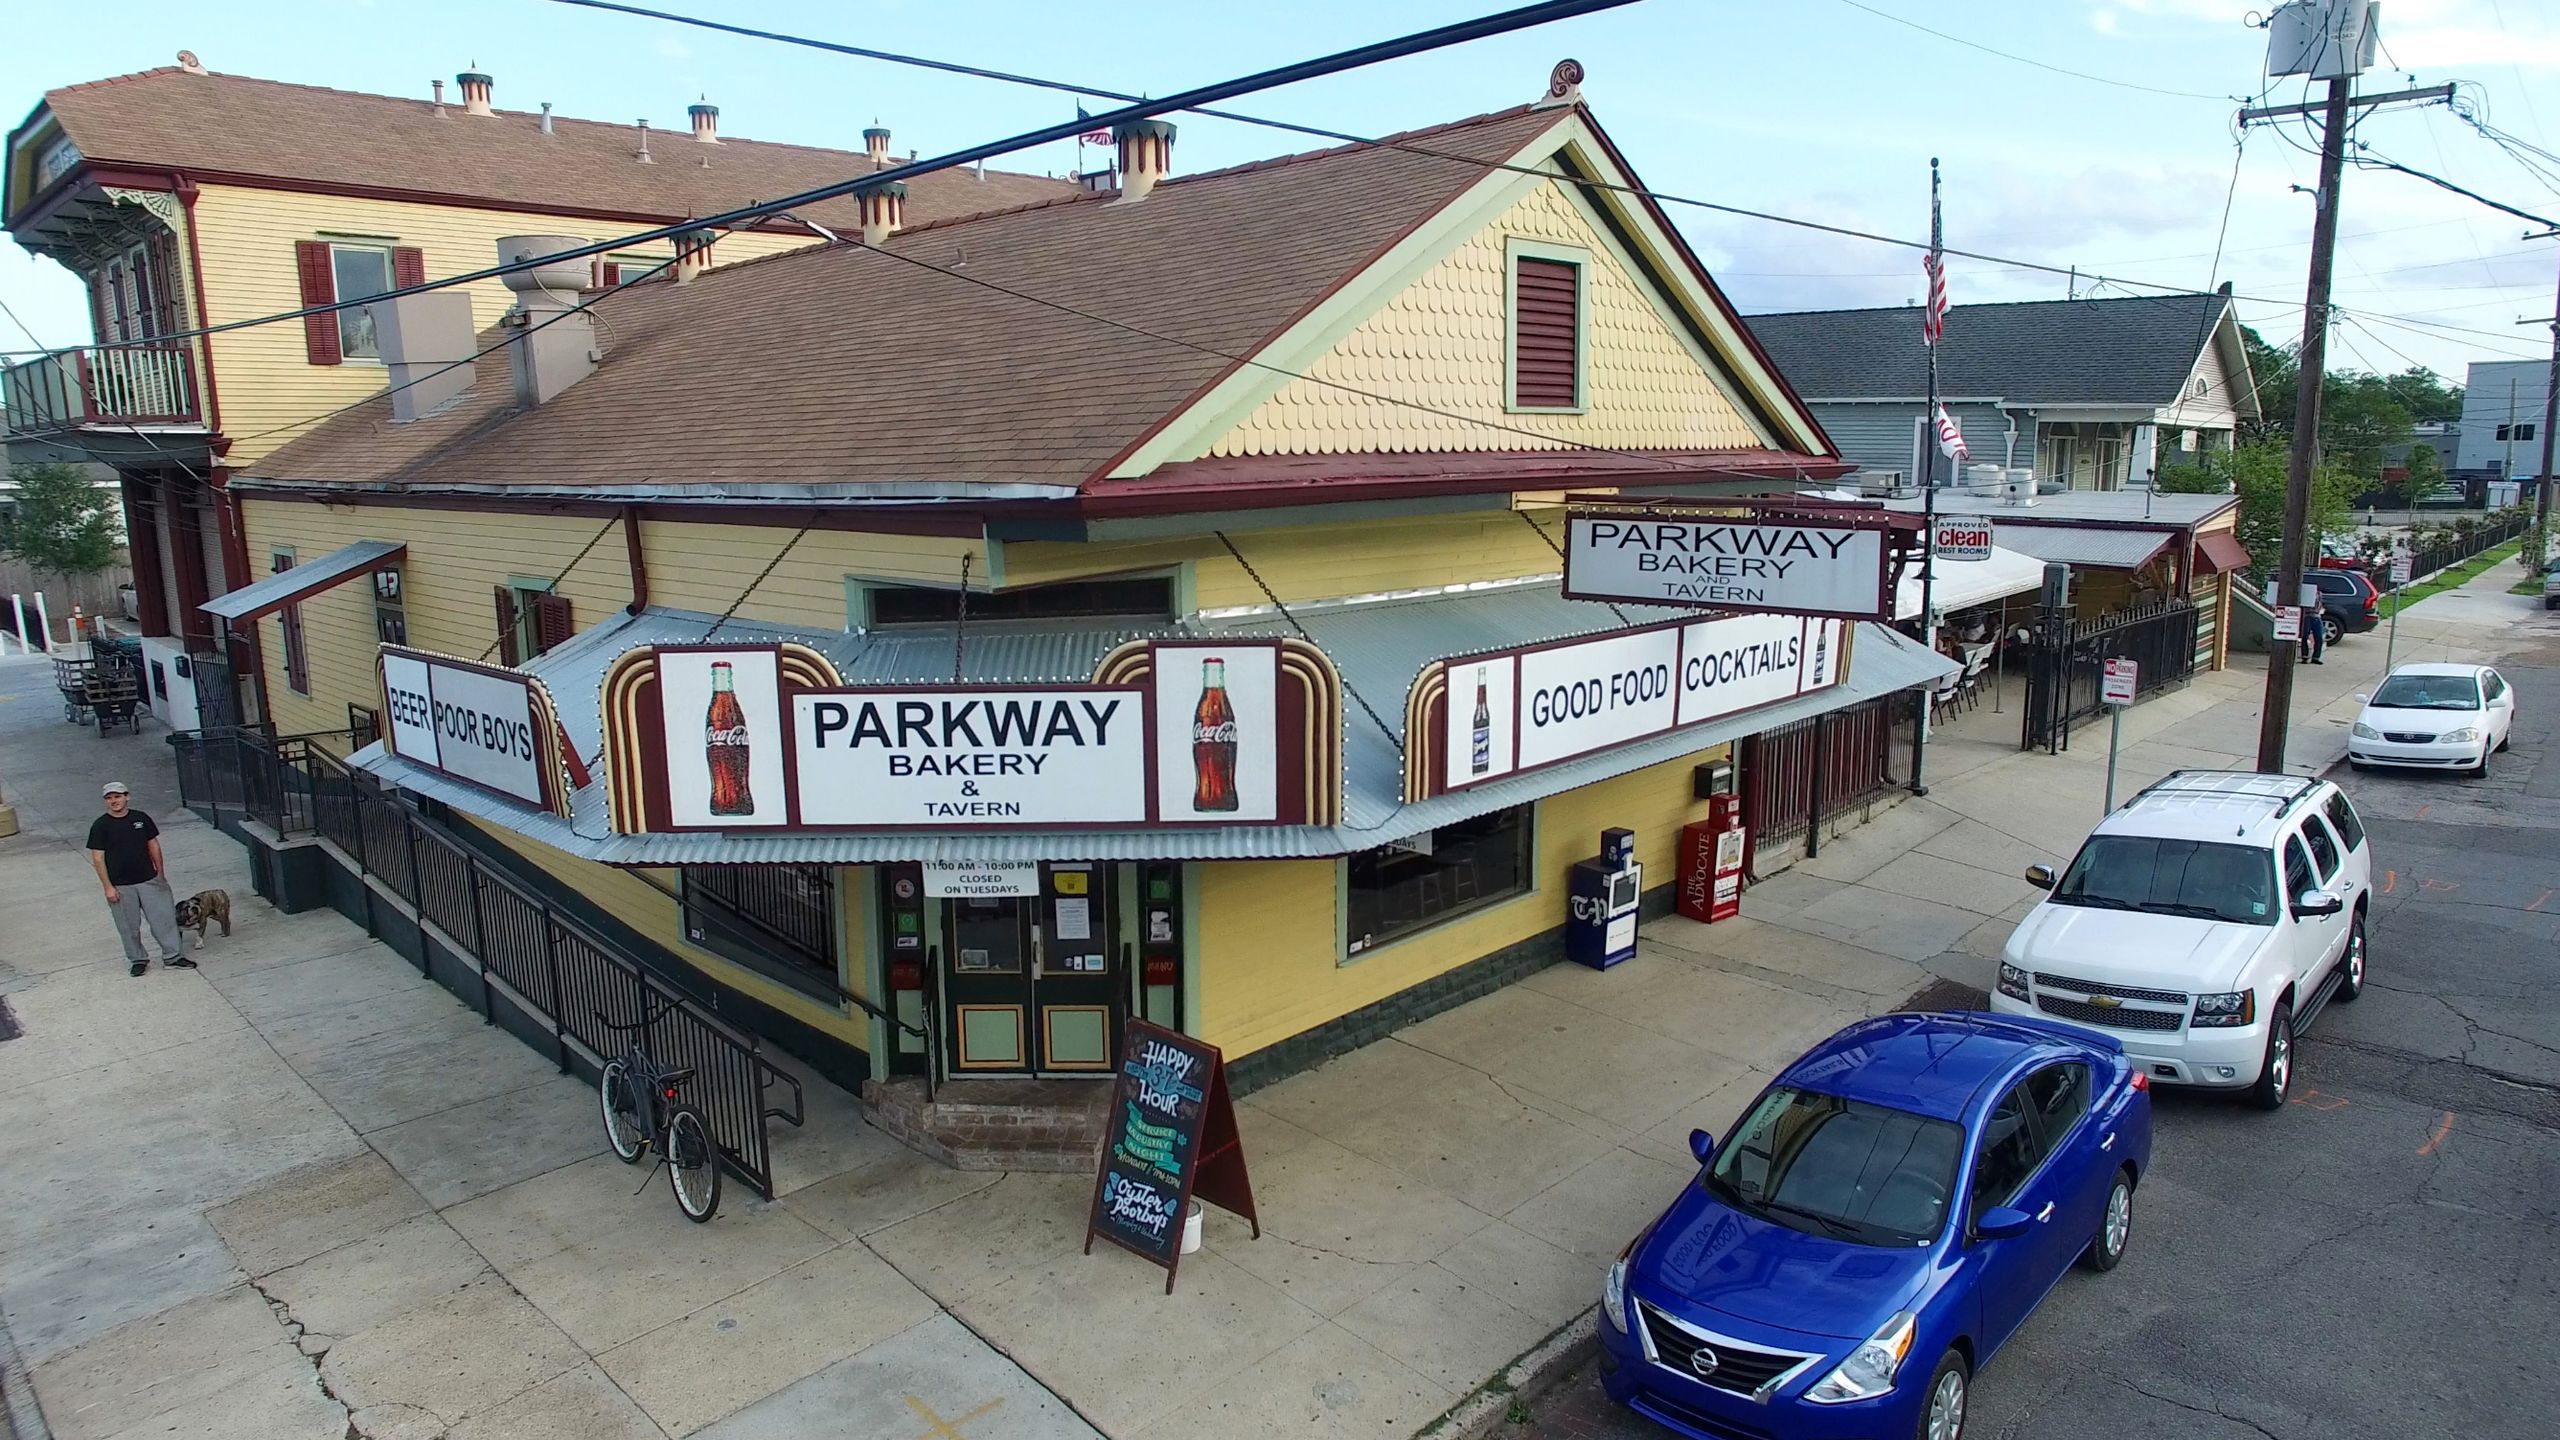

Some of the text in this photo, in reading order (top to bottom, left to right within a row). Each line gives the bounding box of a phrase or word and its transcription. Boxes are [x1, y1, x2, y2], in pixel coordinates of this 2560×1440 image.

[1590, 522, 1855, 560] PARKWAY
[1938, 528, 1988, 547] clean
[1957, 547, 1988, 555] ROOMS
[1638, 552, 1795, 580] BAKERY
[1695, 575, 1731, 585] AND
[1661, 582, 1764, 602] TAVERN
[1686, 636, 1798, 691] COCKTAILS
[1533, 664, 1668, 728] GOOD FOOD
[390, 687, 431, 731] BEER
[435, 700, 532, 762] POOR BOYS
[813, 699, 1121, 749] PARKWAY
[888, 753, 1049, 776] BAKERY
[960, 780, 980, 797] &
[923, 802, 1020, 817] TAVERN
[957, 862, 975, 871] AM
[985, 861, 1015, 871] 10:00
[1017, 861, 1034, 870] PM
[1692, 833, 1710, 912] ADVOCATE
[944, 885, 1020, 894] ON TUESDAYS
[959, 874, 1002, 883] CLOSED
[1687, 875, 1696, 896] THE
[1141, 1040, 1194, 1080] HAPPY
[1139, 1078, 1180, 1117] HOUR
